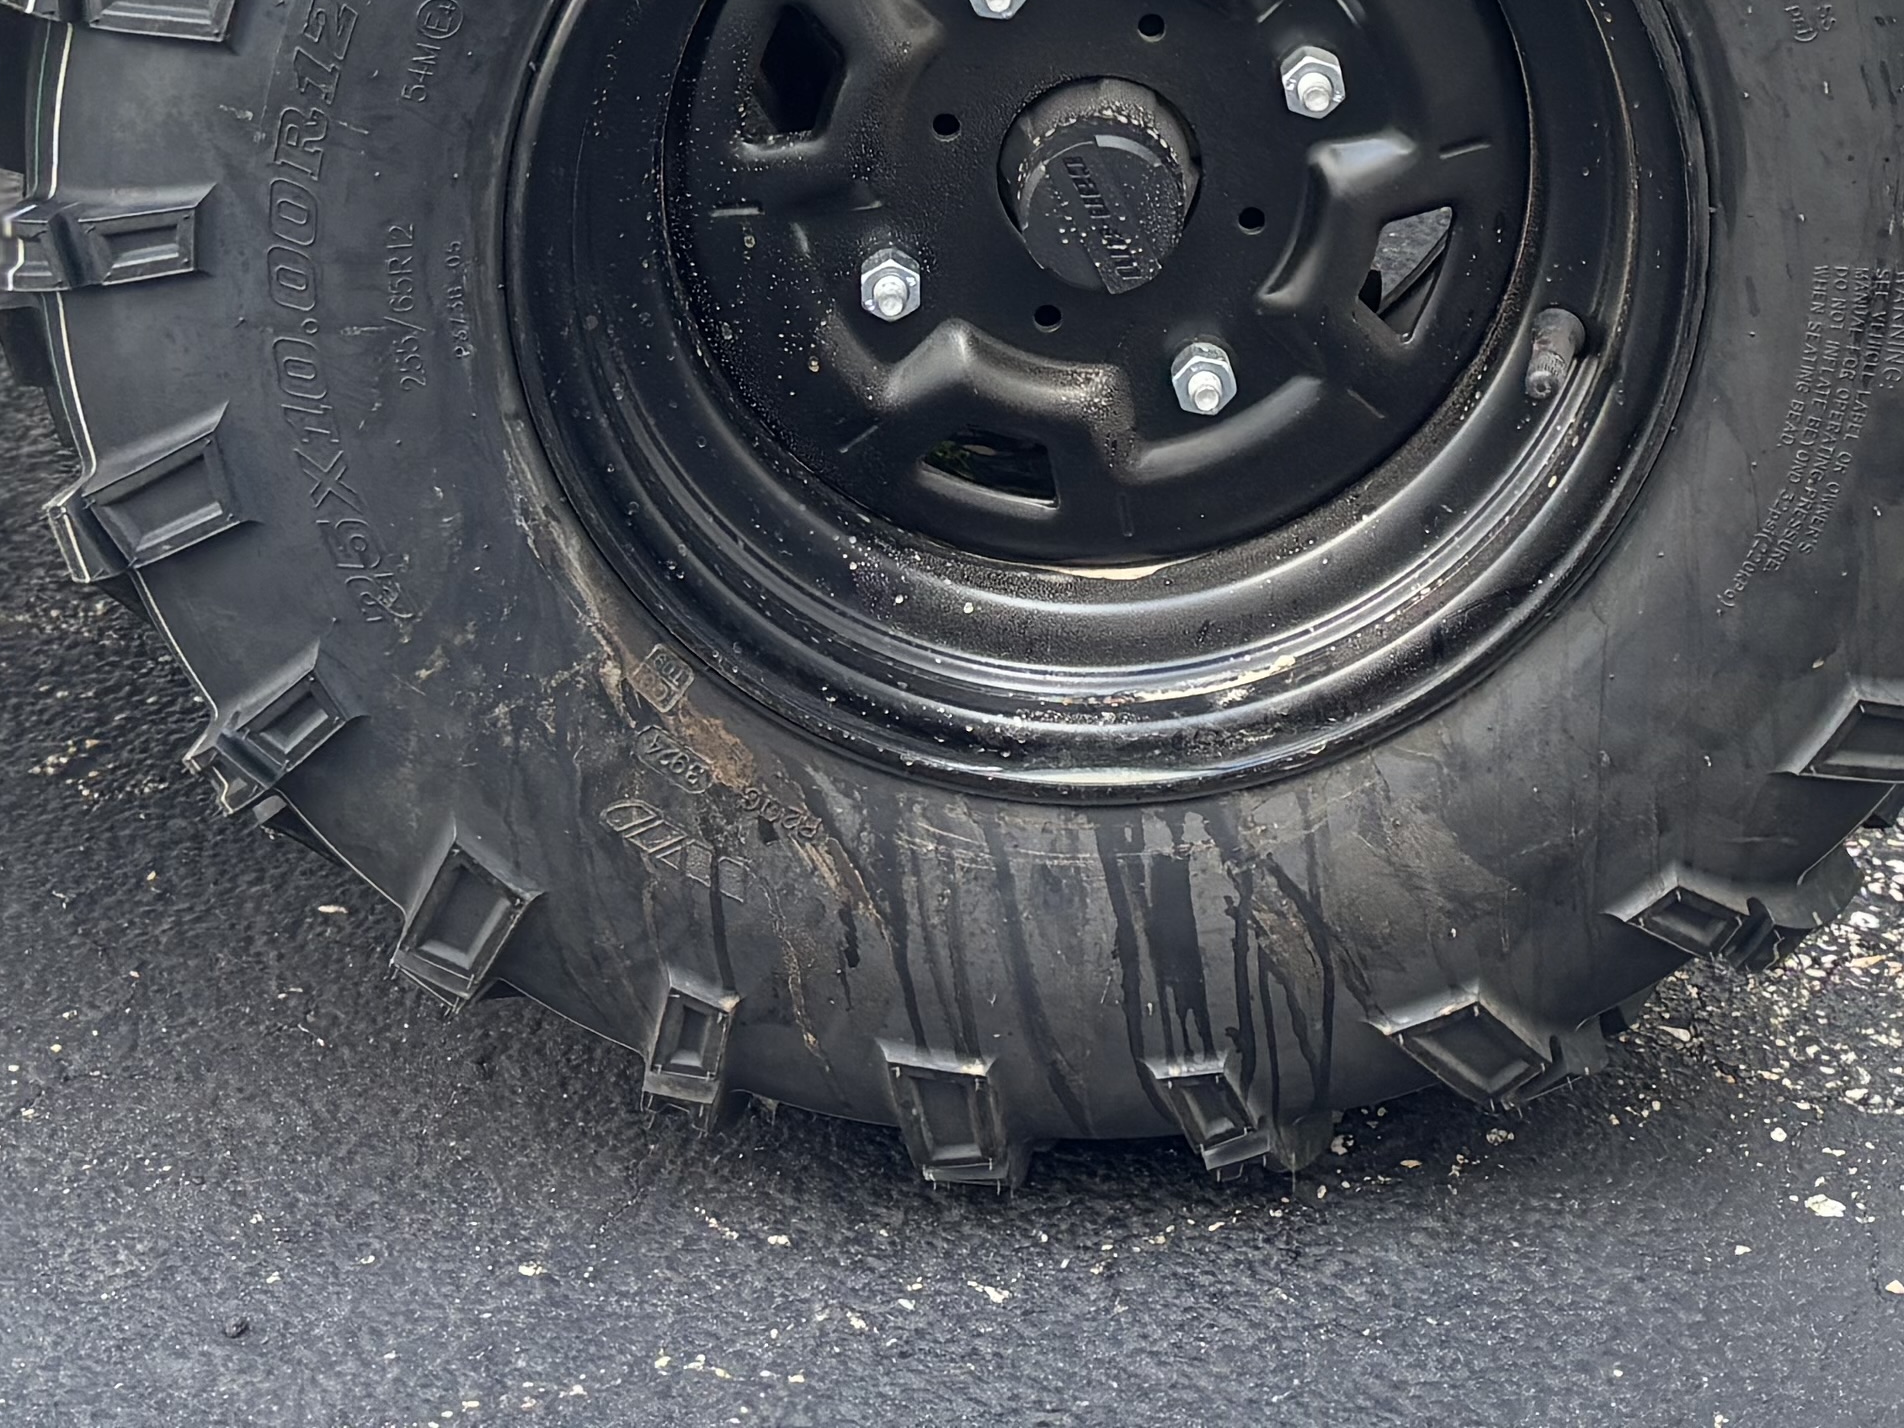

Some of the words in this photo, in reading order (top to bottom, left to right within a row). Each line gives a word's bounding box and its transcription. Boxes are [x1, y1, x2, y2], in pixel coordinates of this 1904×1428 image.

[401, 42, 442, 103] 54M
[386, 224, 426, 390] 255/65R12
[1808, 265, 1829, 316] WHEN
[1831, 267, 1849, 292] DO
[1848, 267, 1870, 335] MANUAL
[1827, 298, 1847, 331] NOT
[1860, 310, 1887, 380] VEHICLE
[1794, 319, 1823, 395] SEATING
[1811, 339, 1840, 411] INFLATE
[1839, 344, 1861, 382] FOR
[1775, 398, 1805, 449] BEAD.
[1843, 388, 1872, 442] LABEL
[1787, 414, 1822, 485] BEYOND
[1832, 449, 1853, 475] OR
[1797, 480, 1841, 556] OWNER'S
